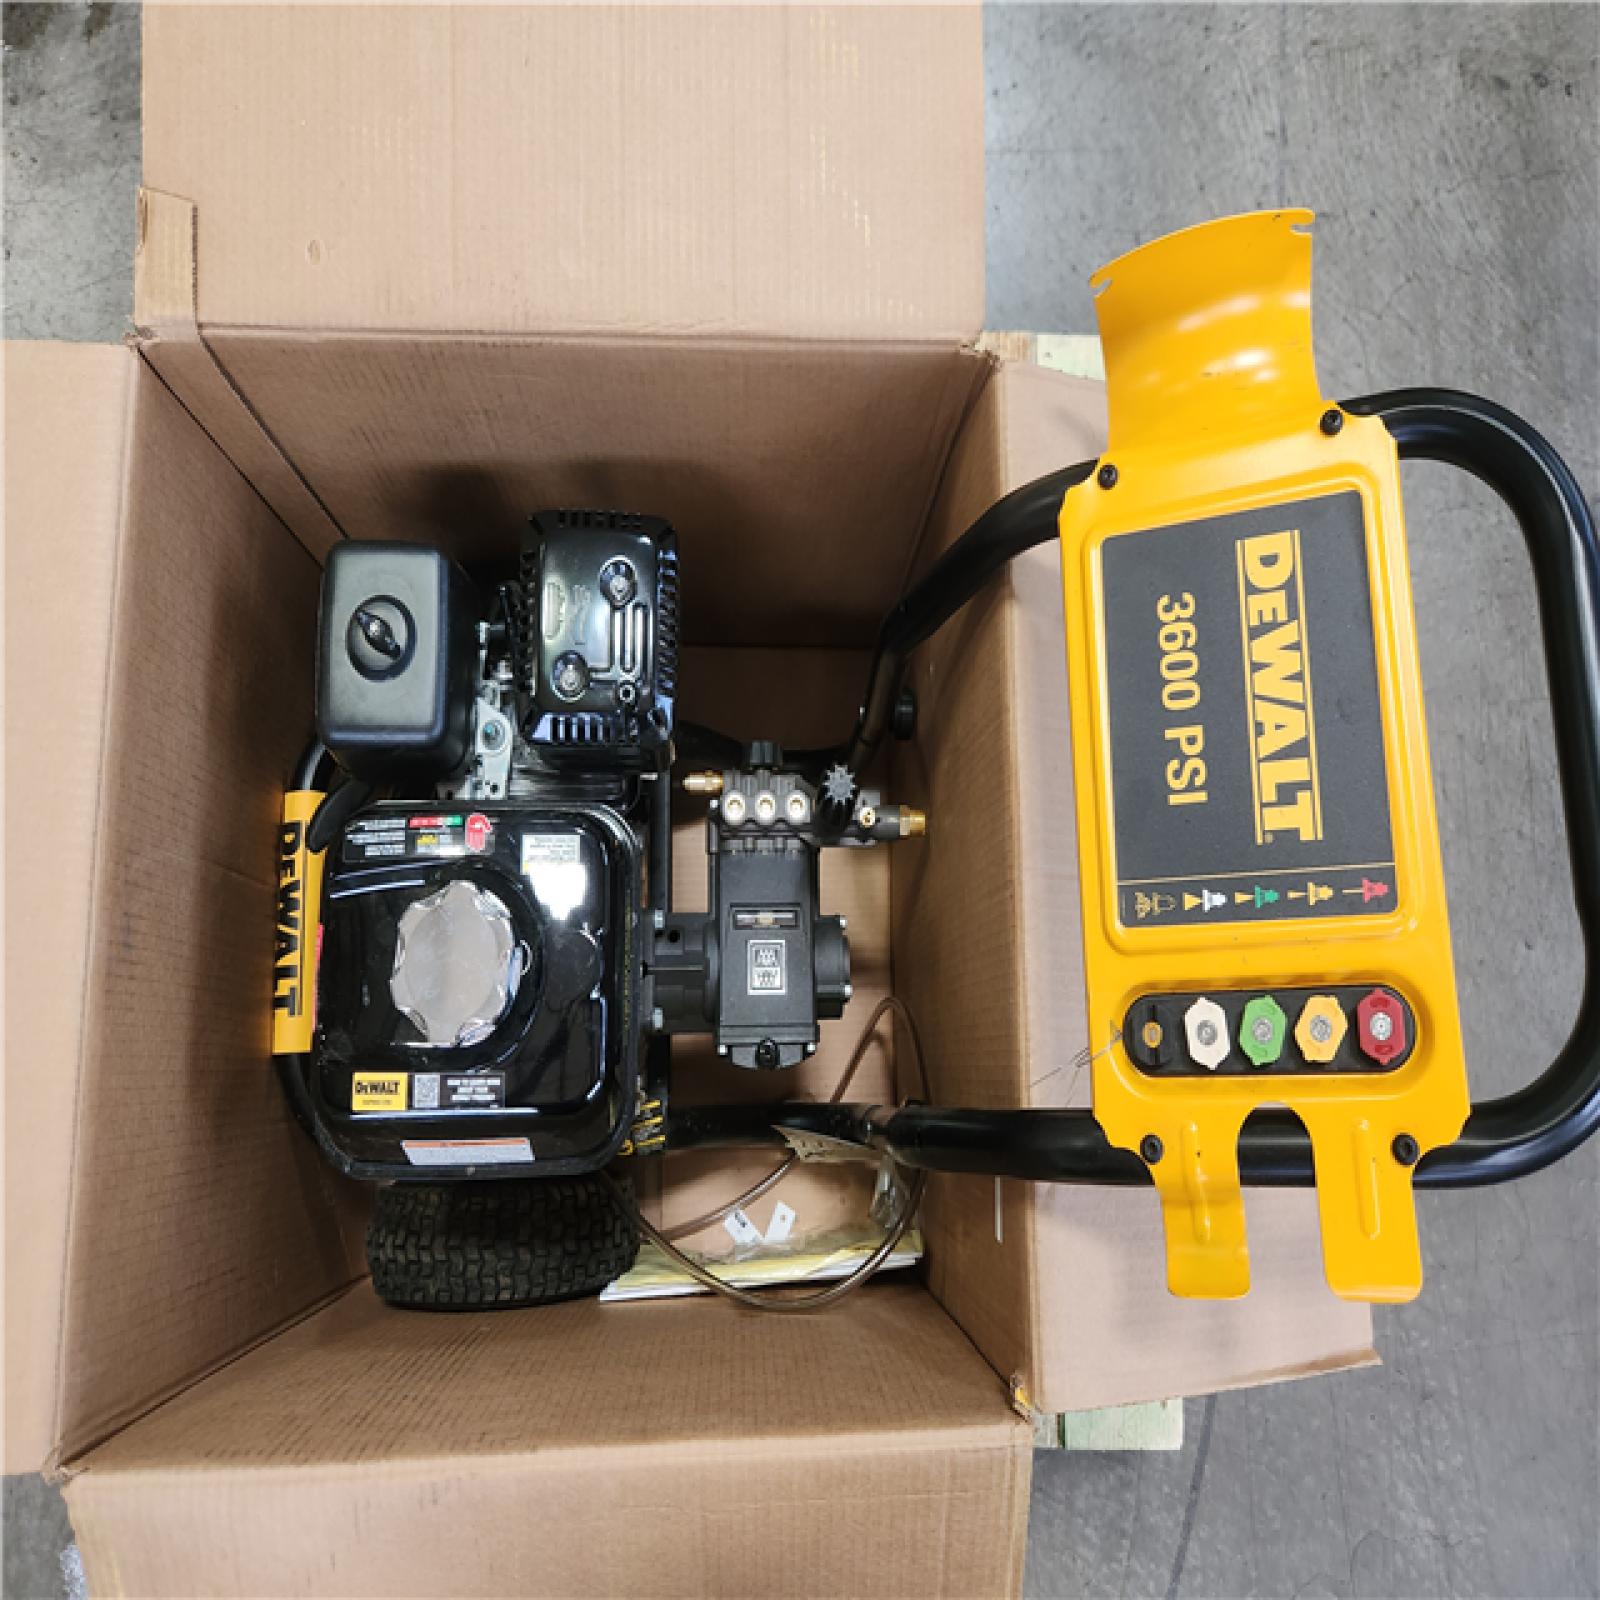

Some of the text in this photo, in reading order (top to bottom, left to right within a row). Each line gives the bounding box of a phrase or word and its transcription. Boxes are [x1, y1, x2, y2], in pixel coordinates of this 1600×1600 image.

[1156, 591, 1208, 806] 3600 PSI
[1240, 530, 1319, 842] DEWALT
[273, 821, 301, 1017] DEWALT
